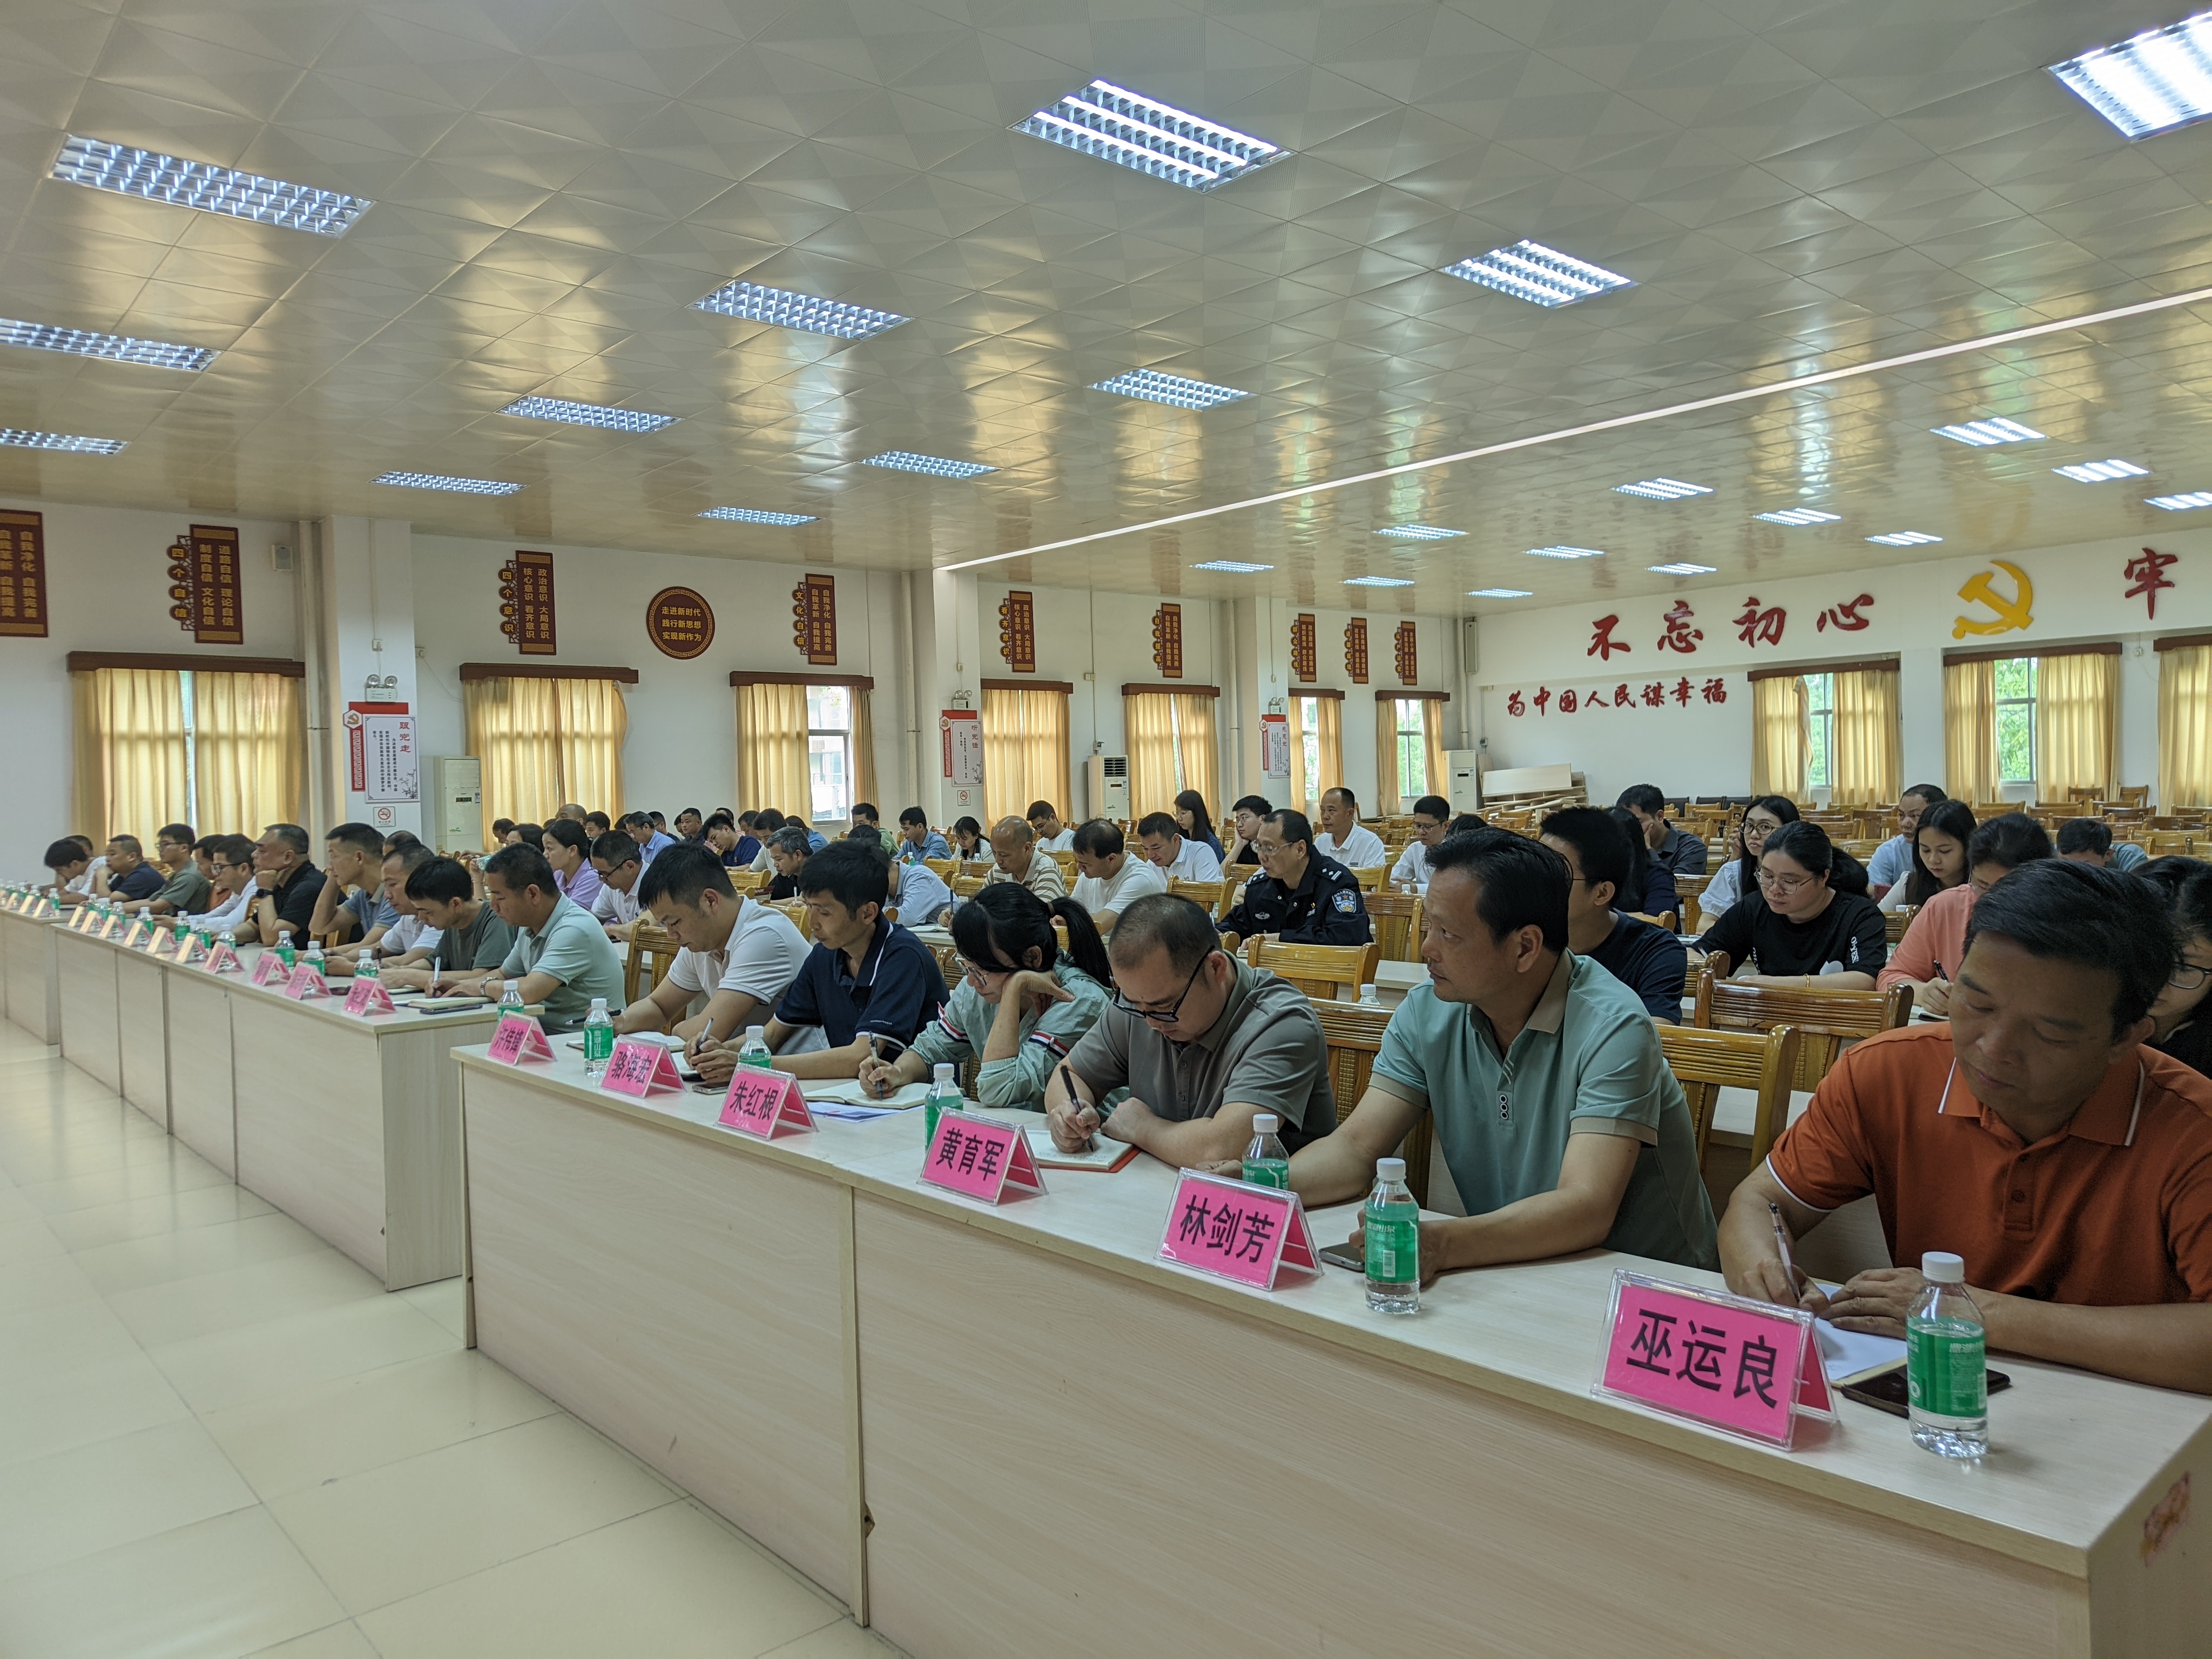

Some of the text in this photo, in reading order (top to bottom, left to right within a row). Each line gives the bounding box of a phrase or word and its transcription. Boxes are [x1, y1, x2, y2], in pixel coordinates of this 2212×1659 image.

[20, 531, 36, 572] 自我净化
[172, 548, 187, 618] 四个自信
[199, 543, 215, 625] 制度自信 文化自信
[218, 545, 234, 626] 道路自信 理论自信
[502, 571, 514, 632] 四个意识
[523, 567, 535, 638] 核心意识 看齐意识
[538, 568, 550, 639] 政治意识 大局意识
[812, 589, 820, 618] 自我革新
[822, 589, 831, 618] 自我净化
[2124, 547, 2178, 620] 牢
[662, 606, 701, 617] 走进新时代
[662, 619, 702, 629] 践行新思想
[662, 631, 702, 642] 实现新作为
[795, 591, 805, 645] 文化自信
[1001, 606, 1009, 655] 看齐意识
[1587, 593, 1874, 662] 不忘初心
[1508, 677, 1728, 718] 为中国人民谋幸福
[399, 721, 411, 753] 跟党走
[730, 1081, 779, 1121] 朱红根
[936, 1127, 1004, 1181] 黄育军
[1179, 1194, 1274, 1263] 林剑芳
[1626, 1308, 1778, 1408] 巫运良
